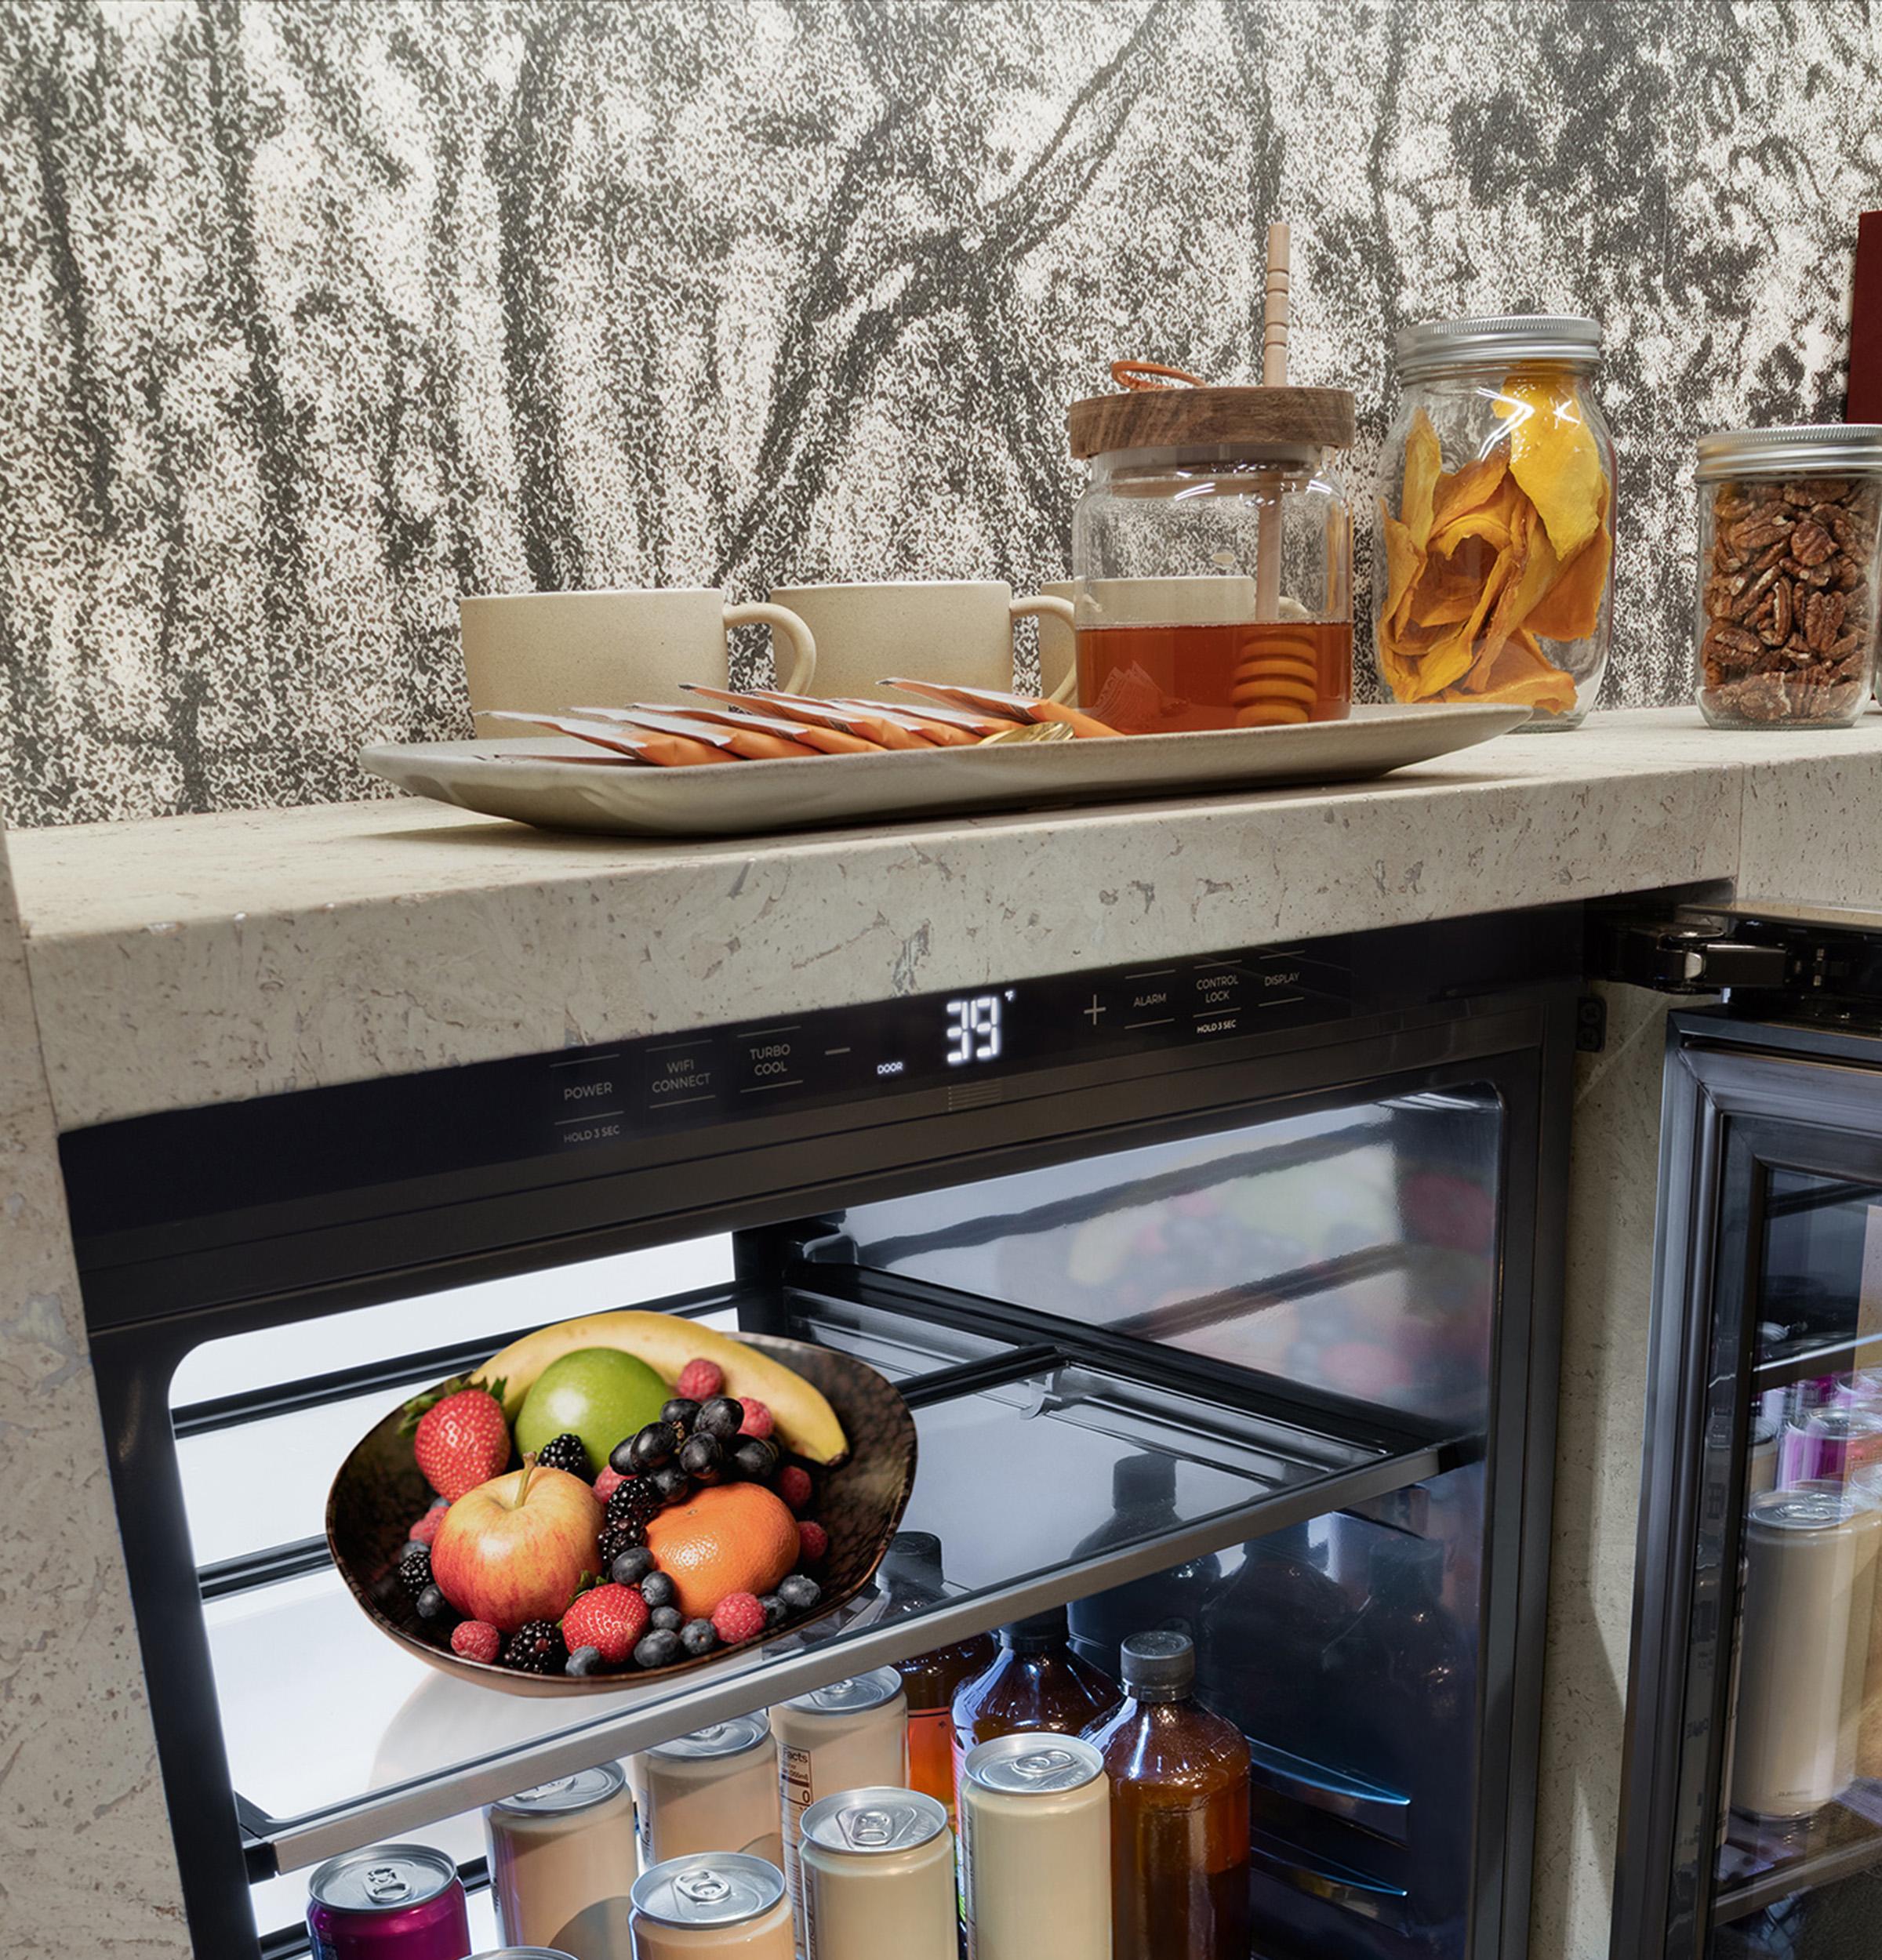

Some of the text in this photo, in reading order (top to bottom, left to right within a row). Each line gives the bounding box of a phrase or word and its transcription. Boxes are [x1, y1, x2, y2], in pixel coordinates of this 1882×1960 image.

[1196, 975, 1239, 991] CONTROL
[1264, 972, 1300, 986] DISPLAY
[1133, 993, 1167, 1007] ALARM
[1205, 991, 1230, 1004] LOCK
[946, 996, 999, 1064] 39
[1197, 1019, 1237, 1034] HOLD 3 SEC
[749, 1044, 790, 1060] TURBO
[667, 1059, 695, 1073] WIFI
[754, 1061, 787, 1076] COOL
[877, 1062, 903, 1075] DOOR
[652, 1073, 711, 1093] CONNECT
[564, 1082, 612, 1101] POWER
[564, 1124, 621, 1143] HOLD 3 SEC
